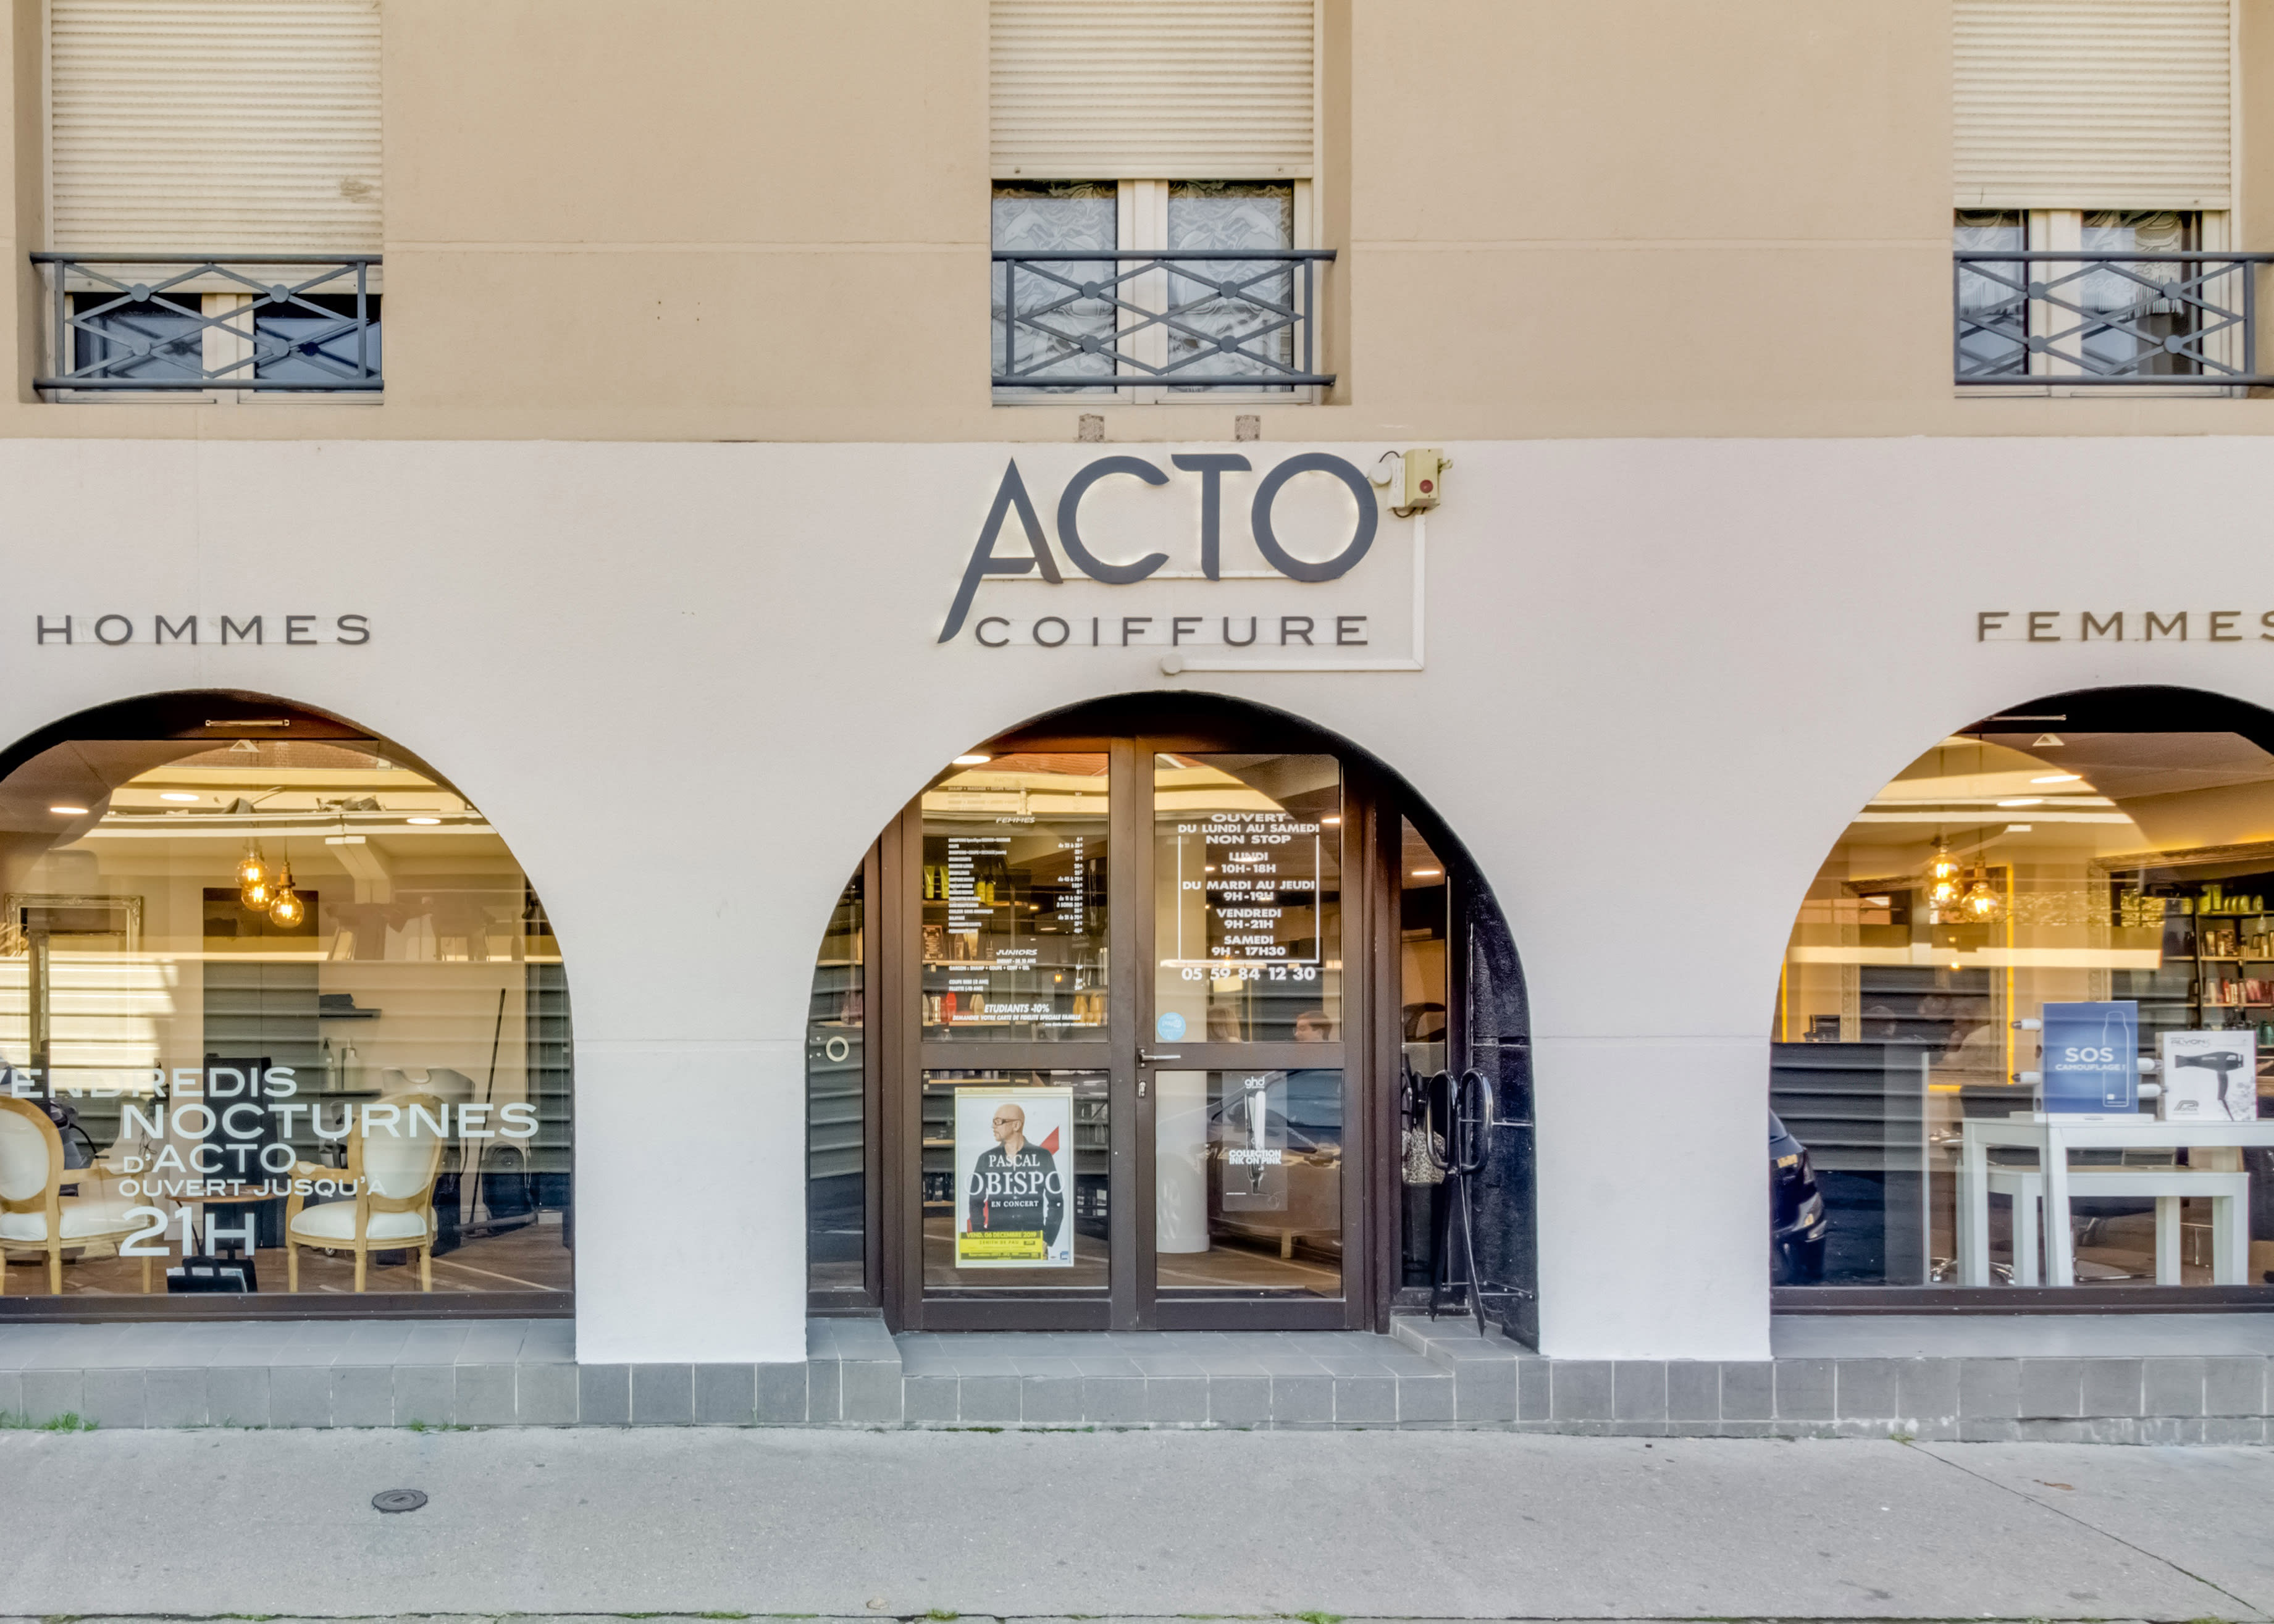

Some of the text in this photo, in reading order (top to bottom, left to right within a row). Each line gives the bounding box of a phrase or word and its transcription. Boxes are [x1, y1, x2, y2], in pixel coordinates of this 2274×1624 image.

[937, 452, 1378, 643] ACTO
[37, 614, 370, 645] HOMMES
[976, 616, 1367, 647] COIFFURE
[1211, 813, 1286, 822] OUVERT
[1178, 824, 1320, 833] DU LUNDI AU SAMEDI
[1206, 835, 1291, 844] NON STOP
[1229, 852, 1268, 861] LUNDI
[1183, 881, 1315, 890] DU MARDI AU JEUDI
[1217, 909, 1281, 918] VENDREDI
[1224, 935, 1273, 945] SAMEDI
[1212, 947, 1230, 956] 9H
[1245, 947, 1286, 956] 17H30
[1181, 967, 1315, 981] 05 59 84 12 30
[984, 1004, 1049, 1013] ETUDIANTS -10%
[2065, 1047, 2113, 1062] SOS
[1244, 1076, 1265, 1089] ghd
[124, 1103, 539, 1140] NOCTURNES
[989, 1154, 1040, 1167] PASCAL
[118, 1179, 246, 1197] OUVERT
[964, 1171, 1065, 1195] OBISPO
[119, 1206, 255, 1257] 21H
